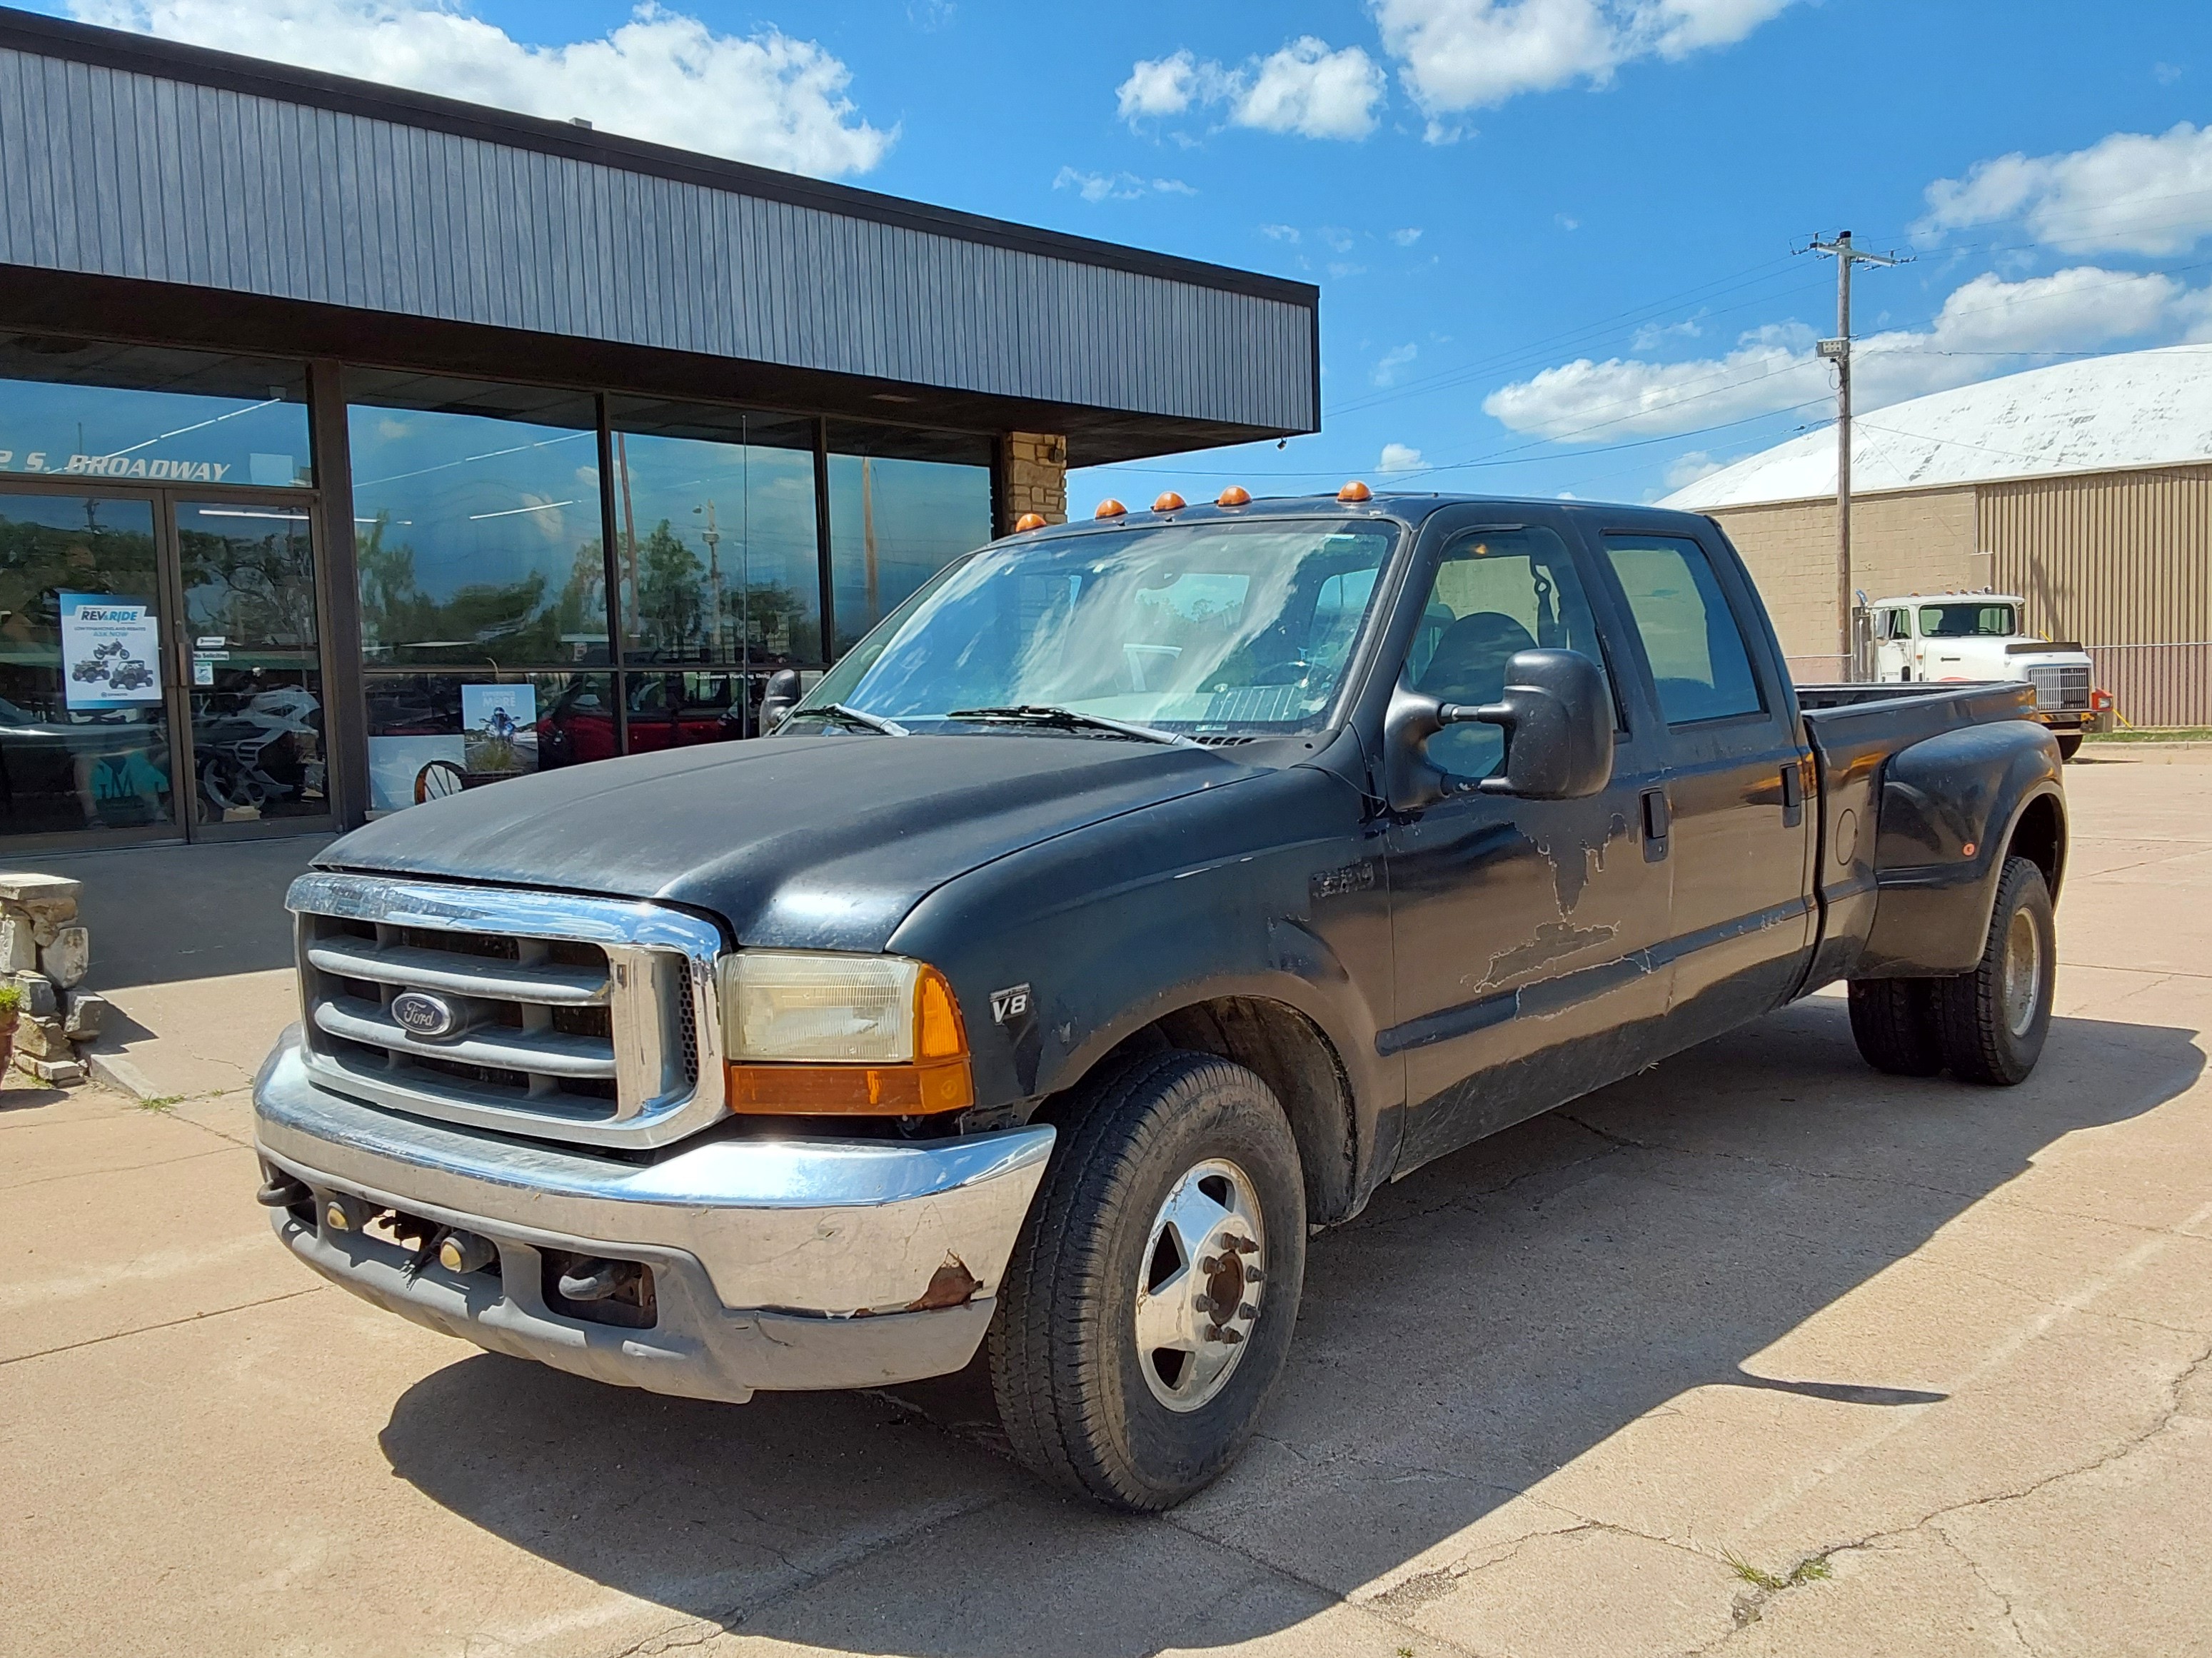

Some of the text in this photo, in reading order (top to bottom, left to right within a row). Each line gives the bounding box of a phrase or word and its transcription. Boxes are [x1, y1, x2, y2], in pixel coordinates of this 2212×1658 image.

[24, 452, 51, 472] S.
[66, 454, 231, 481] BROADWAY
[483, 696, 516, 708] MORE
[403, 1000, 436, 1027] Ford
[992, 994, 1027, 1023] V8
